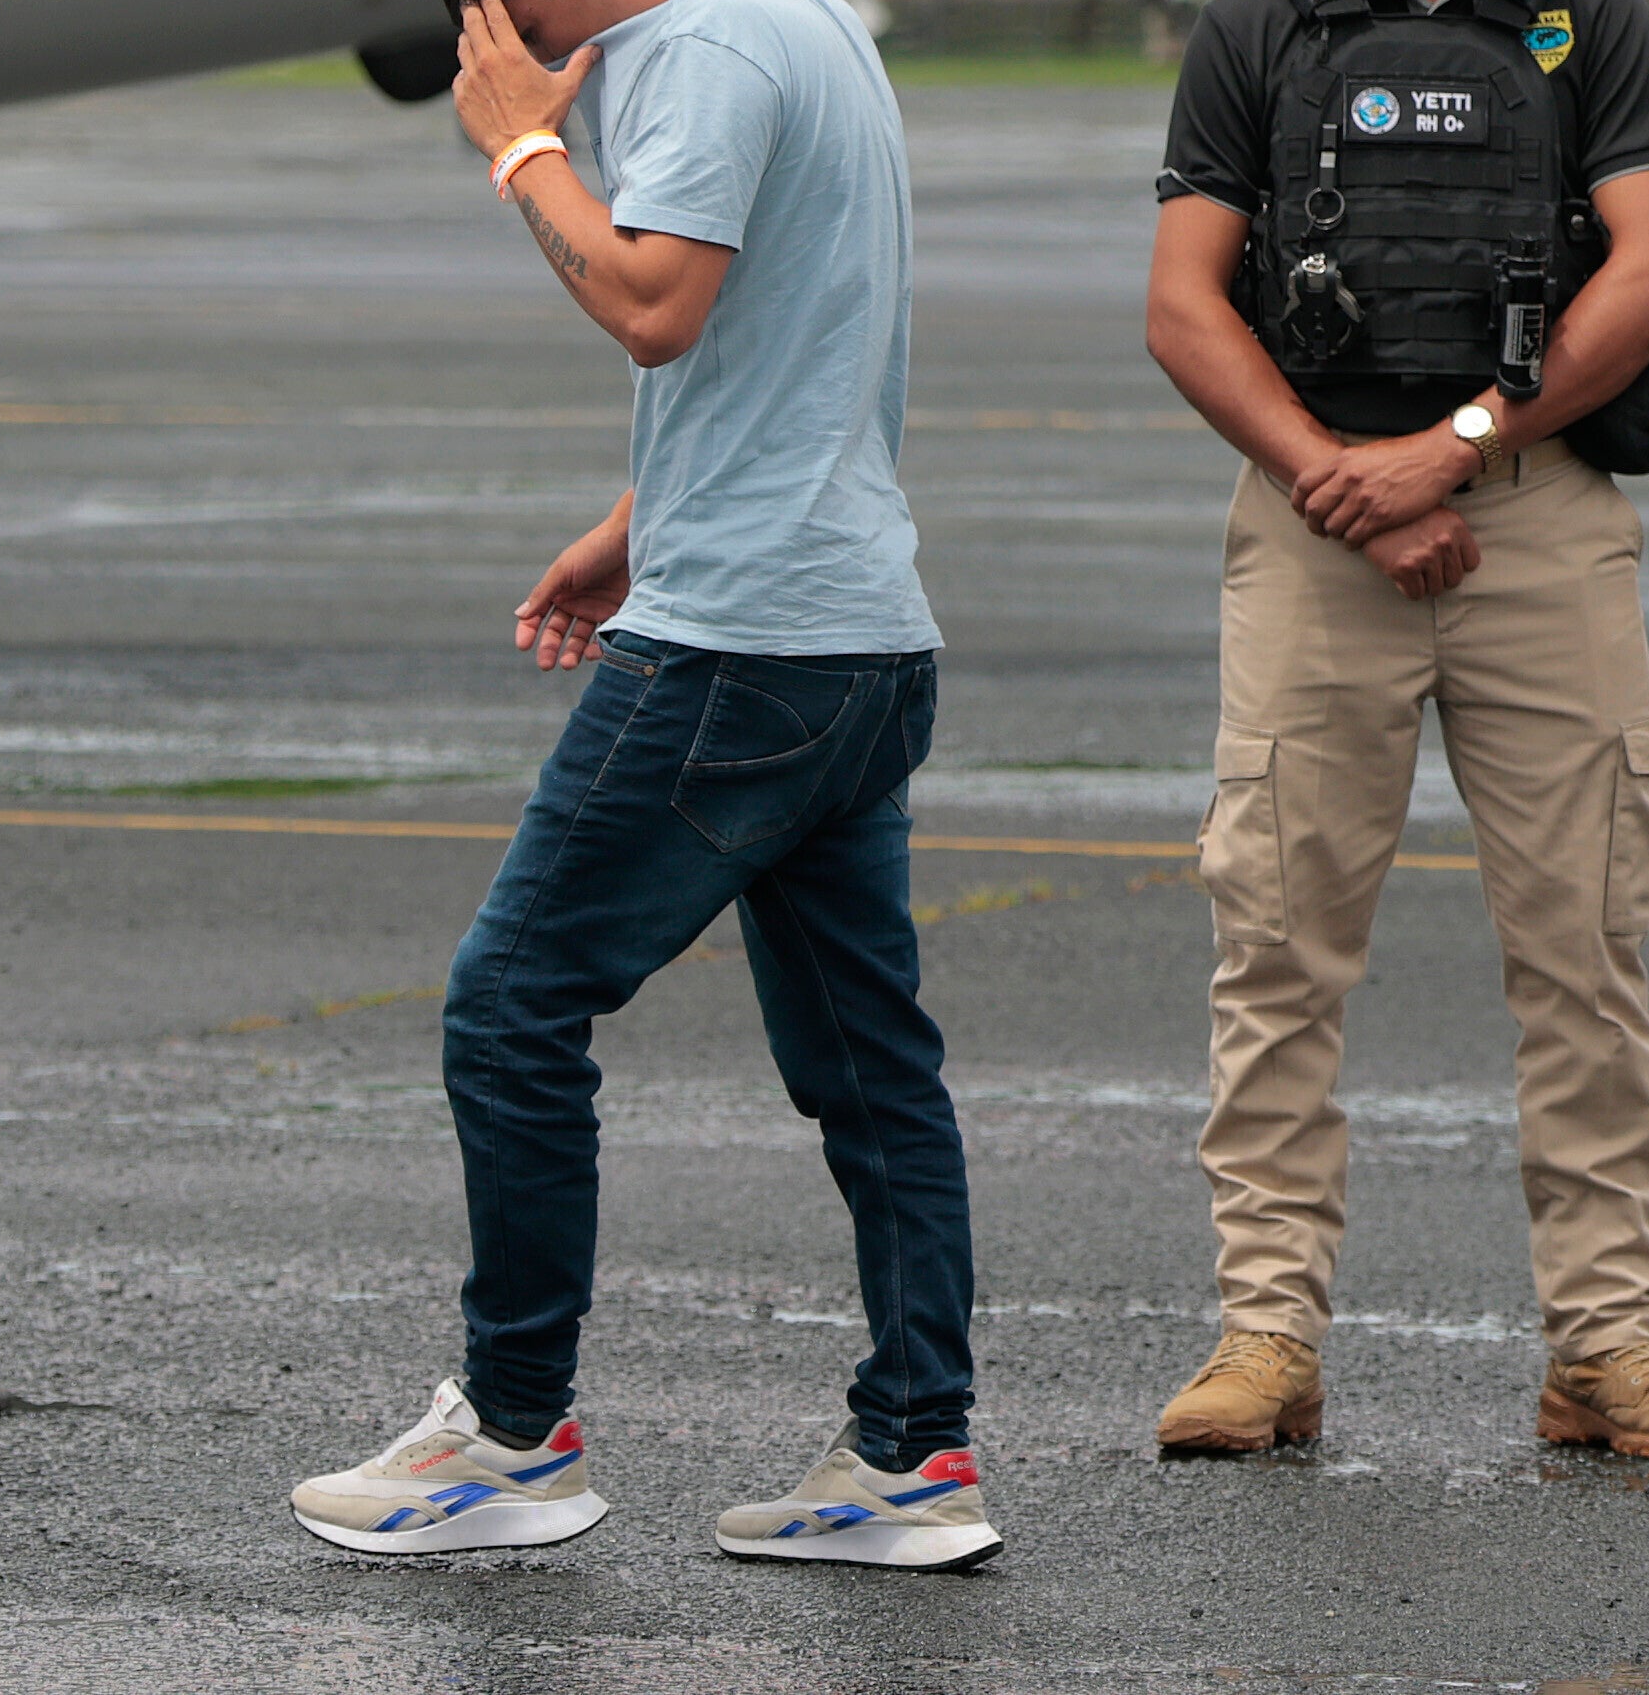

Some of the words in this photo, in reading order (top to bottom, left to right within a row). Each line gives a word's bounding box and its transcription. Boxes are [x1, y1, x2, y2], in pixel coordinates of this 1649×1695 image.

[1411, 91, 1472, 112] YETTI
[1416, 114, 1438, 133] RH
[409, 1447, 458, 1476] Reebok
